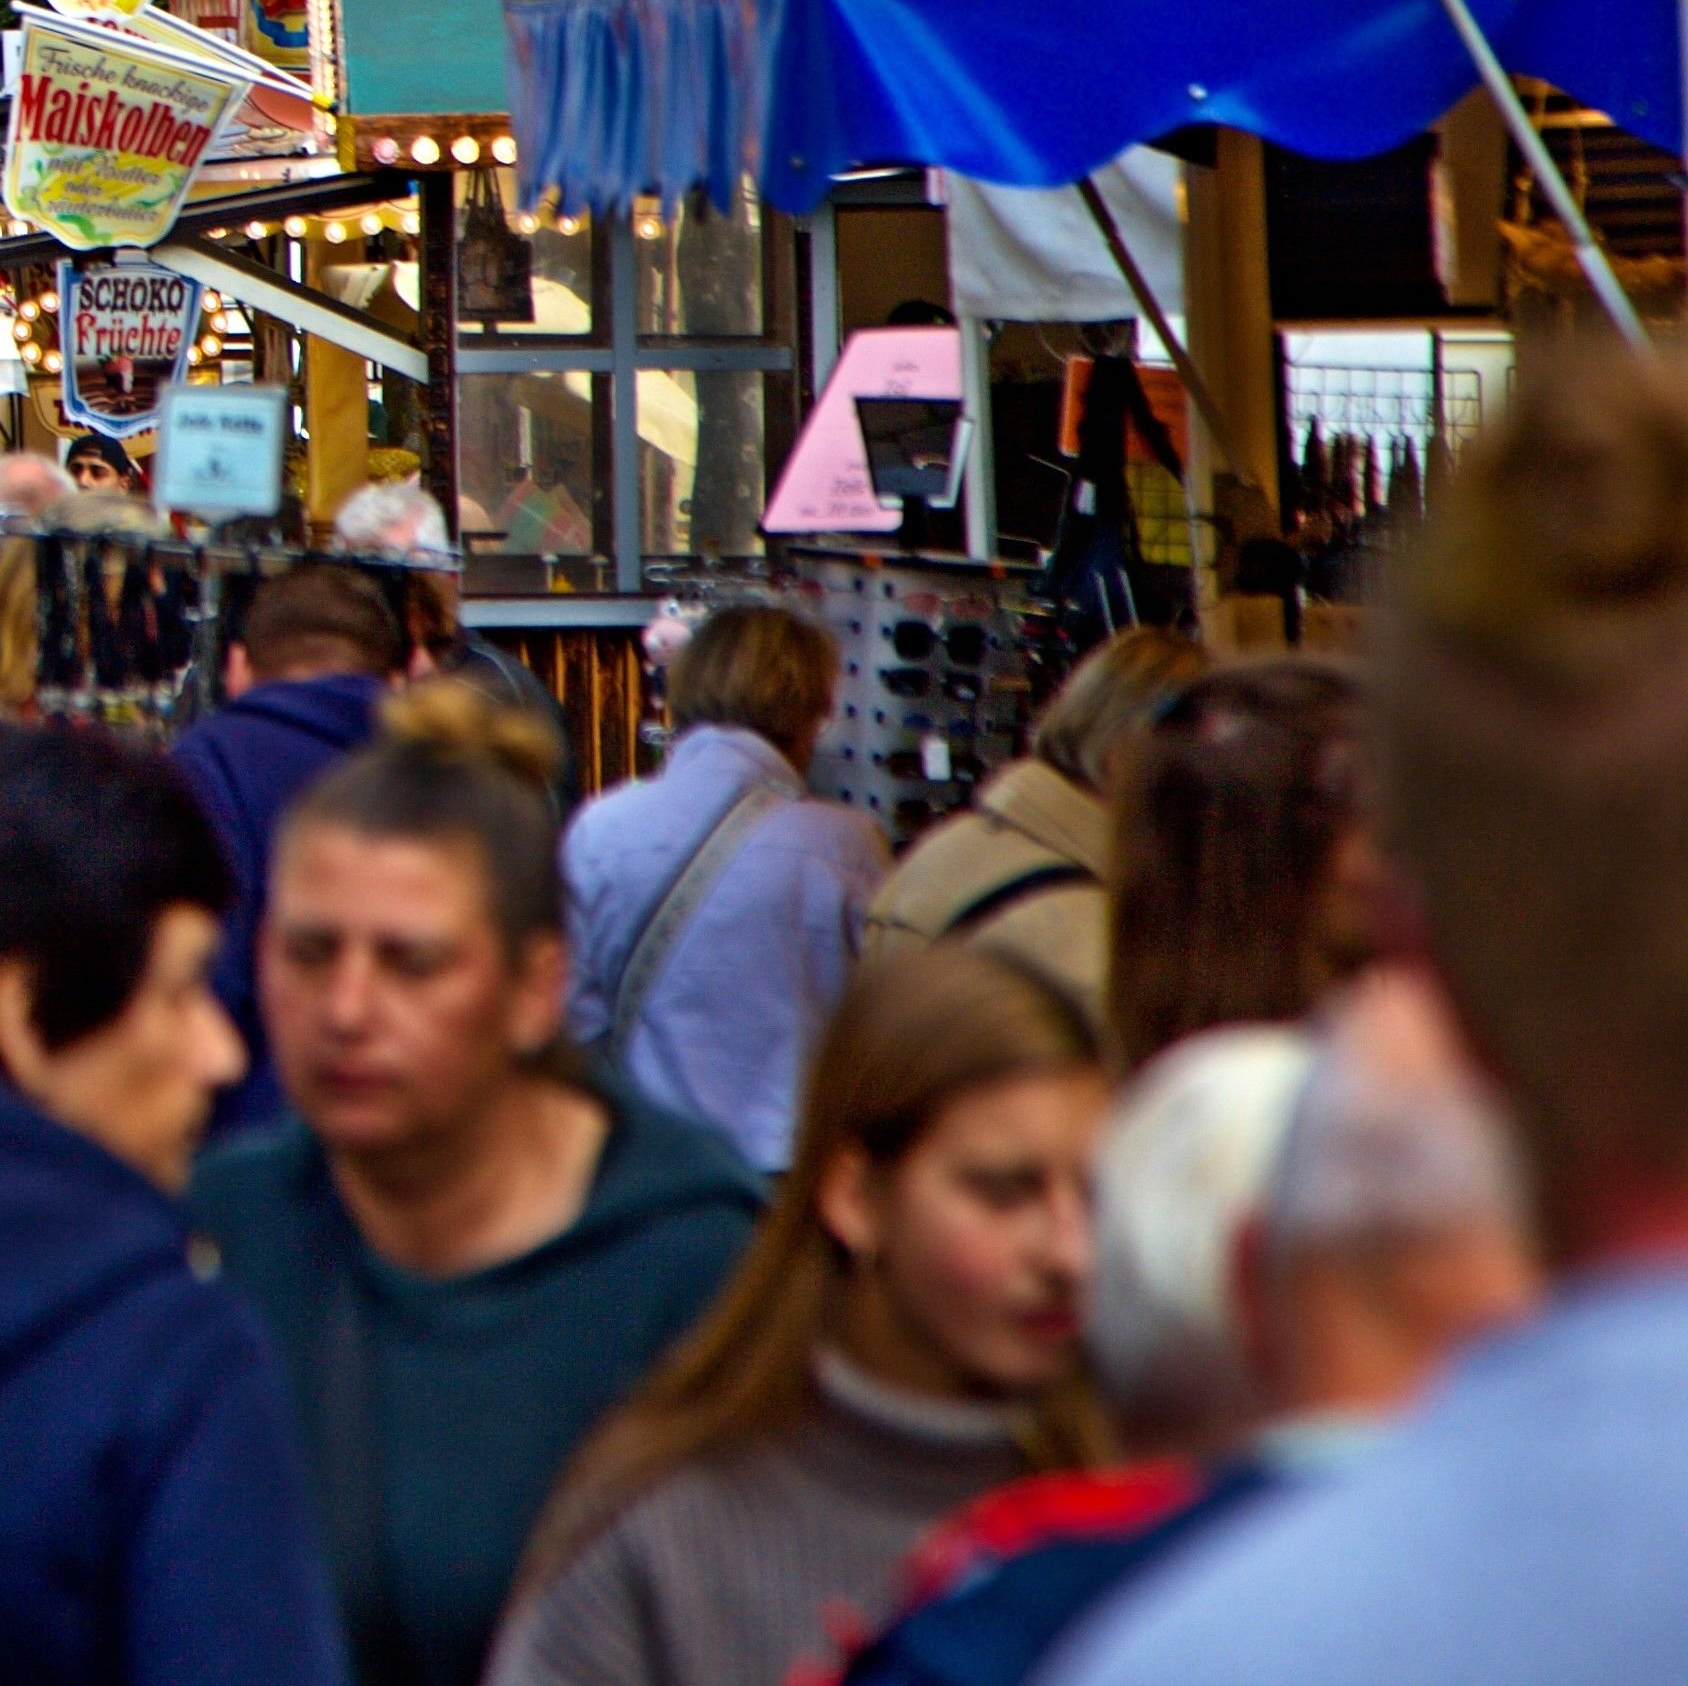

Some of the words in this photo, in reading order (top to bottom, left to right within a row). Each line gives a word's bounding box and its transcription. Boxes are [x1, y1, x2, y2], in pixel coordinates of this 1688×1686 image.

[39, 45, 118, 83] Frische
[122, 65, 209, 114] knackige
[15, 73, 212, 168] Maiskolben
[79, 276, 185, 314] SCHOKO
[75, 313, 182, 358] Früchte
